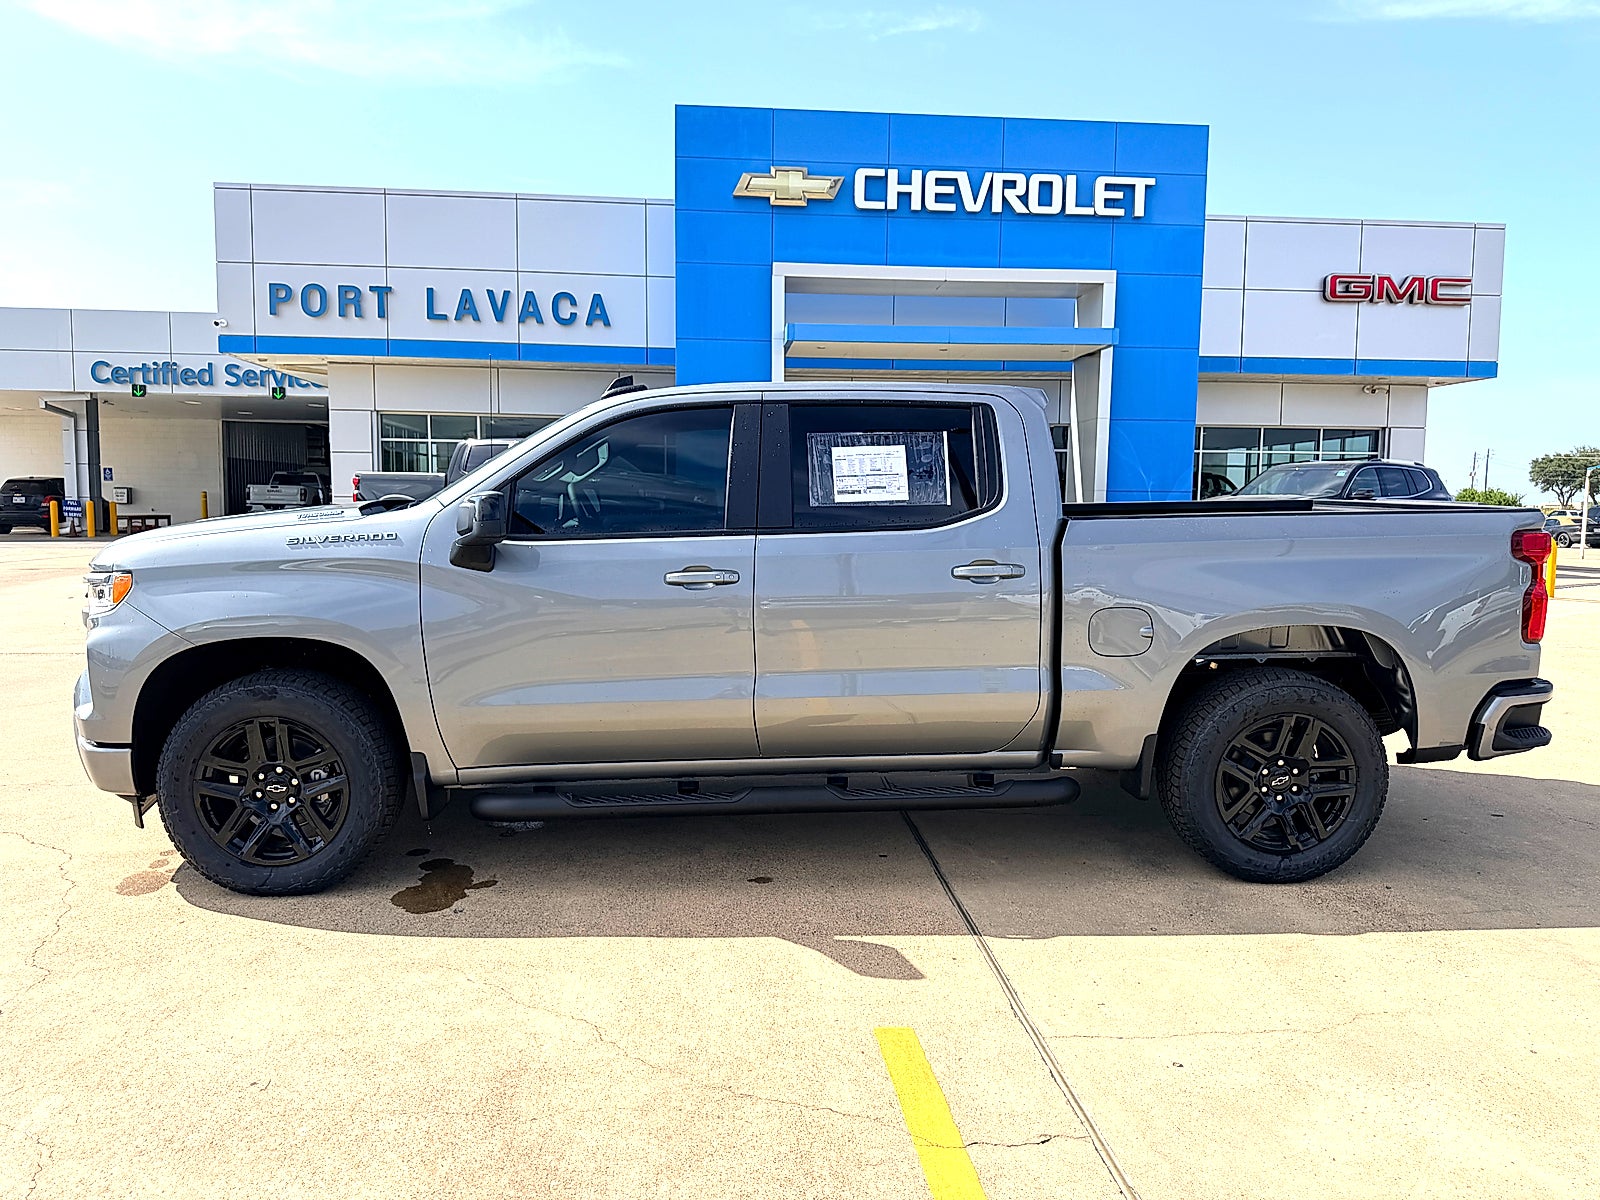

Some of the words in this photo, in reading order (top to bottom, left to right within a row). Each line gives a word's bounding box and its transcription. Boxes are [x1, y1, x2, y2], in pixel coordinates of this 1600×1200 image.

[854, 168, 1156, 217] CHEVROLET
[268, 282, 392, 319] PORT
[425, 287, 612, 327] LAVACA
[1323, 273, 1472, 305] GMC
[90, 361, 214, 386] Certified
[224, 363, 326, 388] Servic
[286, 531, 398, 546] SILVERADO
